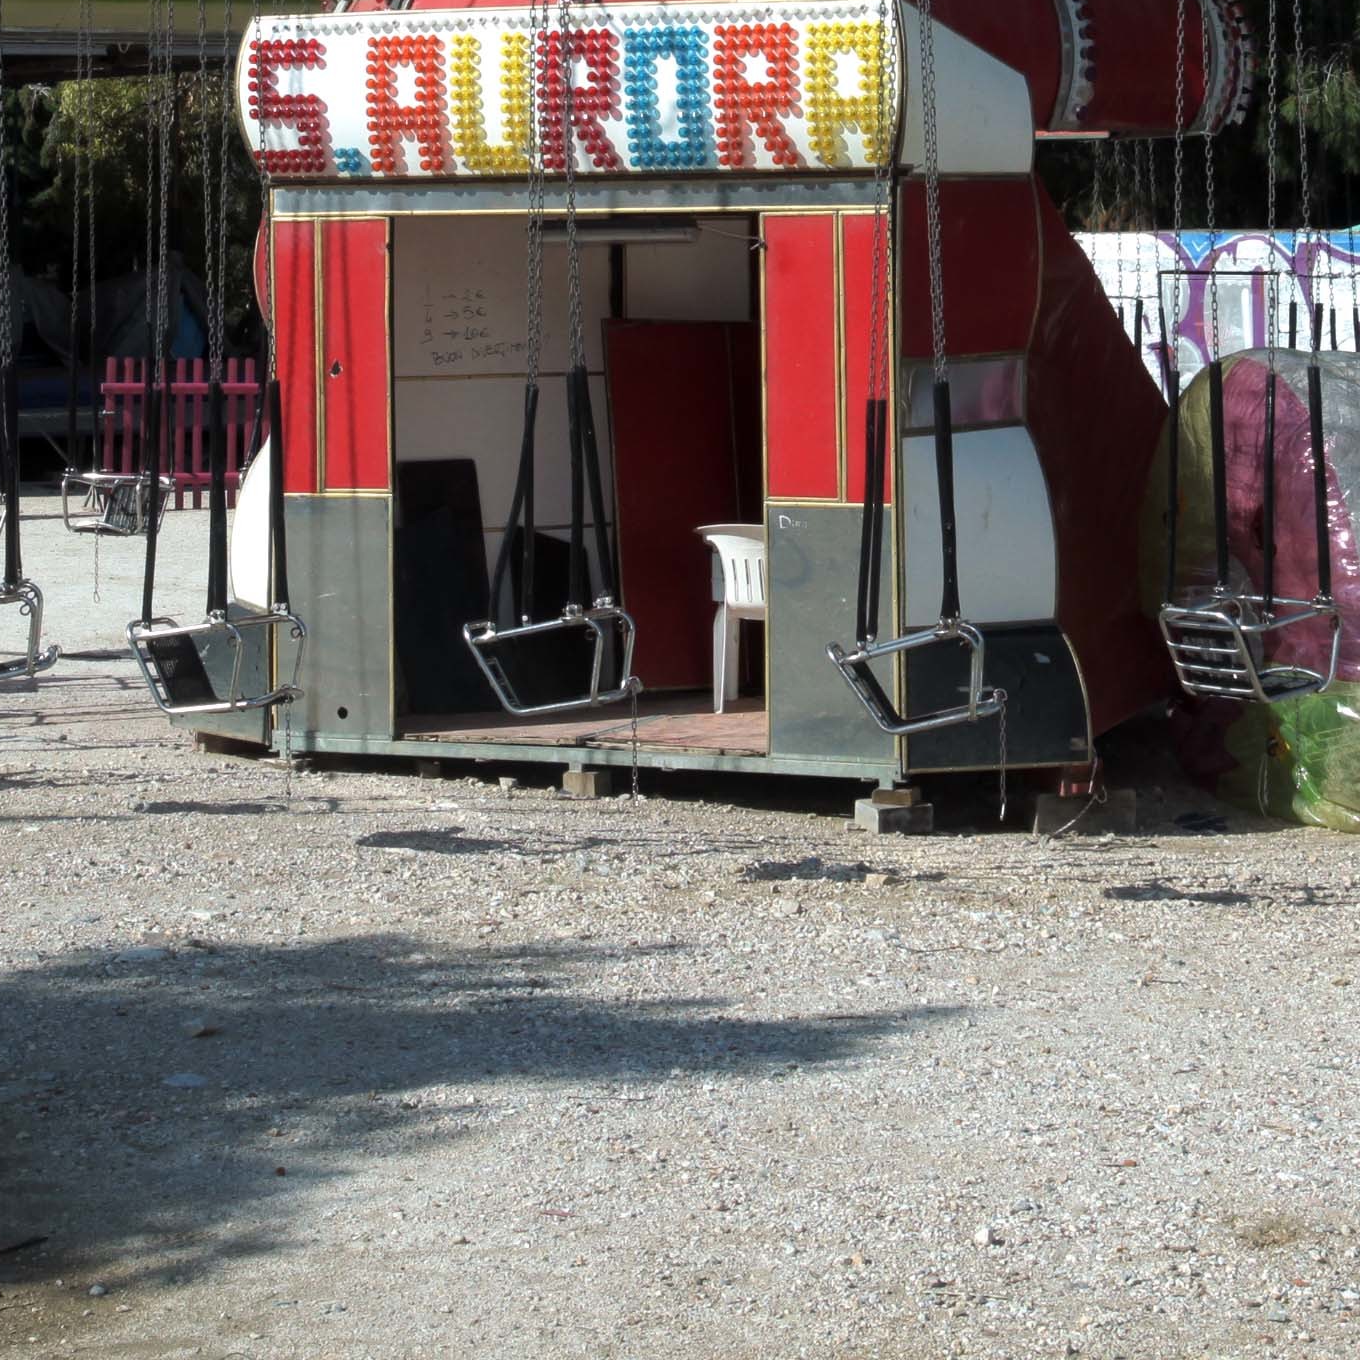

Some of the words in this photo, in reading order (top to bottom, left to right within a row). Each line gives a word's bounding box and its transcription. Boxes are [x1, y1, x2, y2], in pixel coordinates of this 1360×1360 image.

[367, 21, 896, 173] AURORA
[462, 305, 488, 320] 5€
[463, 326, 489, 341] 10€
